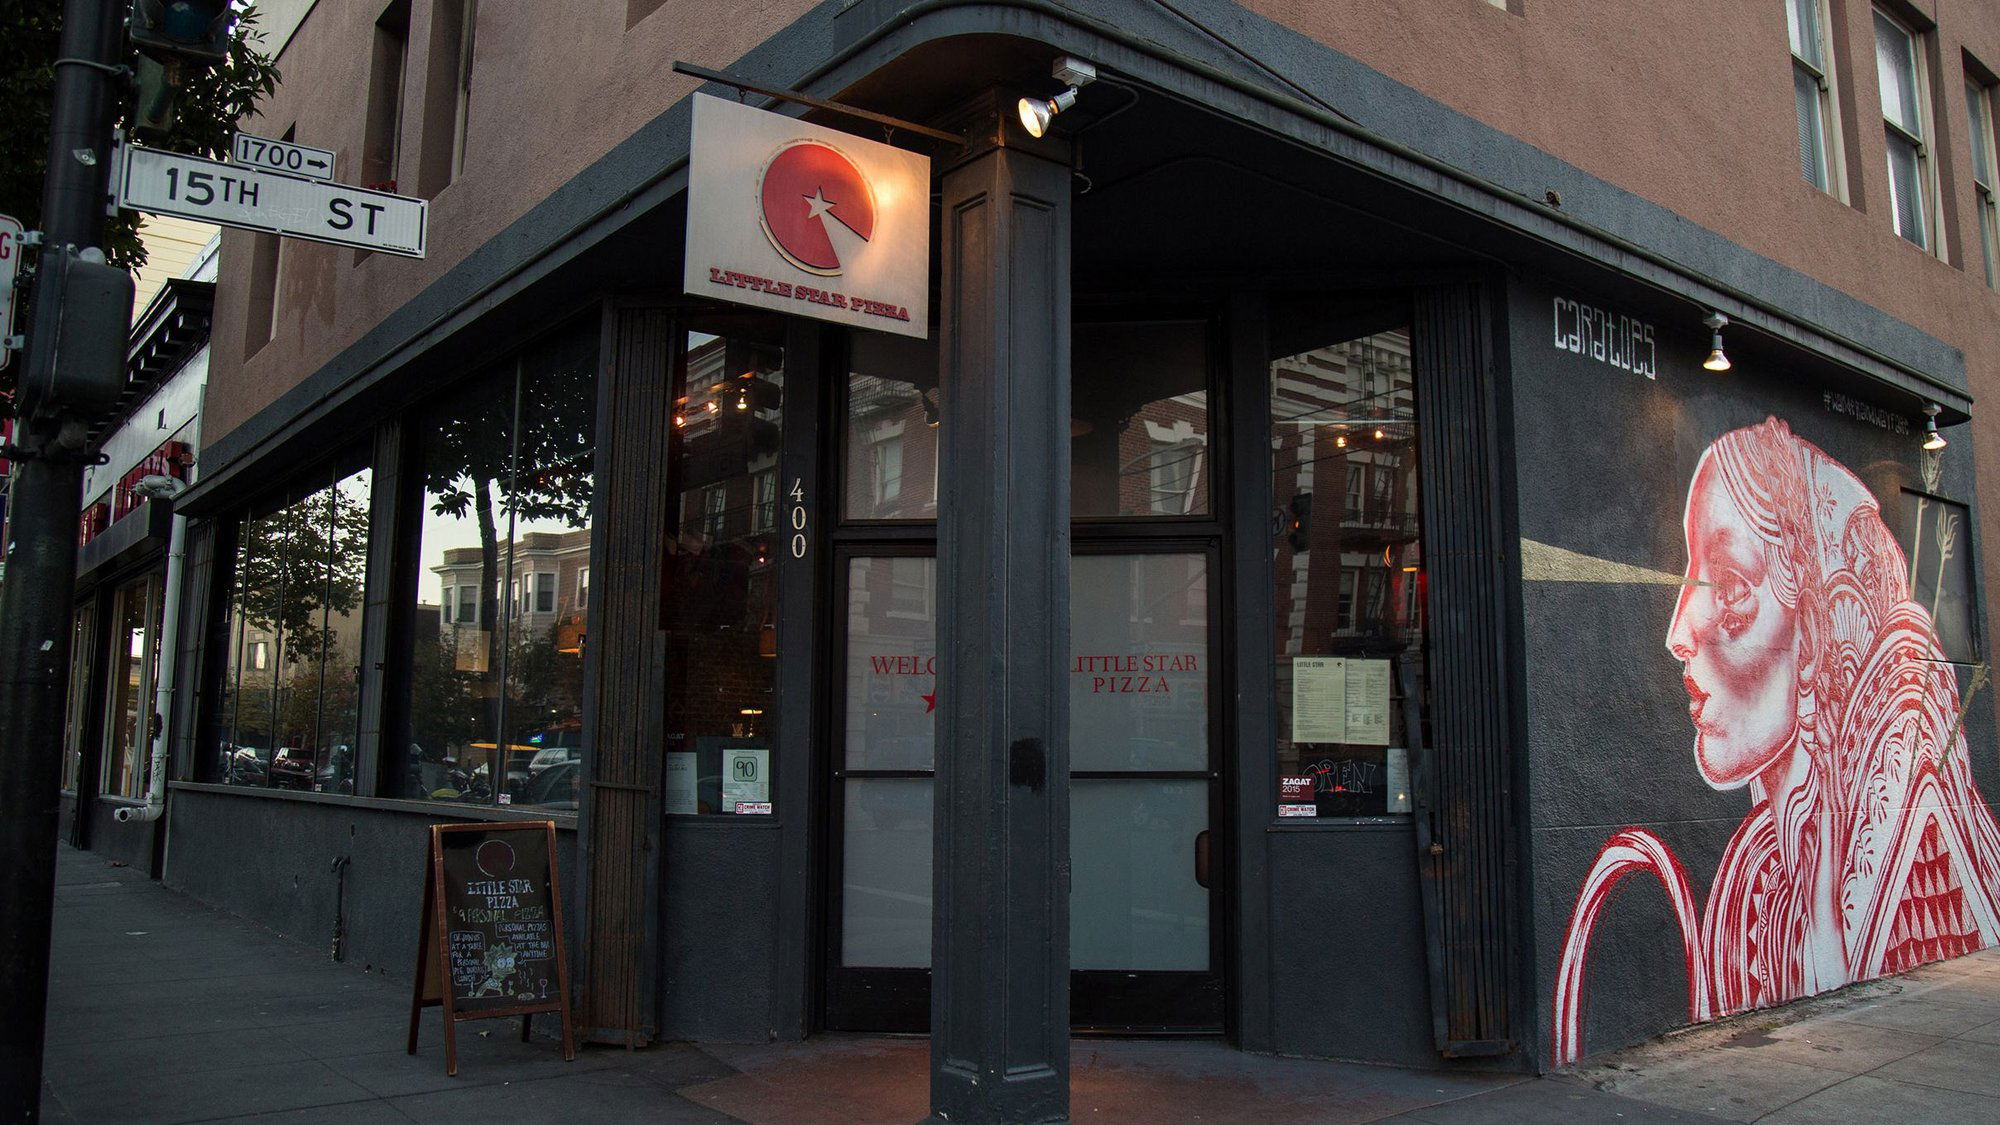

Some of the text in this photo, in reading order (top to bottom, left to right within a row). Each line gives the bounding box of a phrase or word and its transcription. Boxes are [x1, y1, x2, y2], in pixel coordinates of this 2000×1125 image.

[241, 138, 303, 170] 1700
[166, 167, 259, 207] 15TH
[327, 198, 385, 235] ST
[709, 267, 911, 322] LITTLE STAR PIZZA
[789, 477, 807, 559] 400
[870, 655, 1198, 675] WELC ITTLE STAR
[1093, 675, 1170, 693] PIZZA
[736, 760, 755, 778] 90
[1282, 777, 1312, 786] ZAGAT
[1282, 785, 1301, 793] 2015
[467, 879, 535, 895] LITTLE STAR
[486, 896, 519, 909] PIZZA
